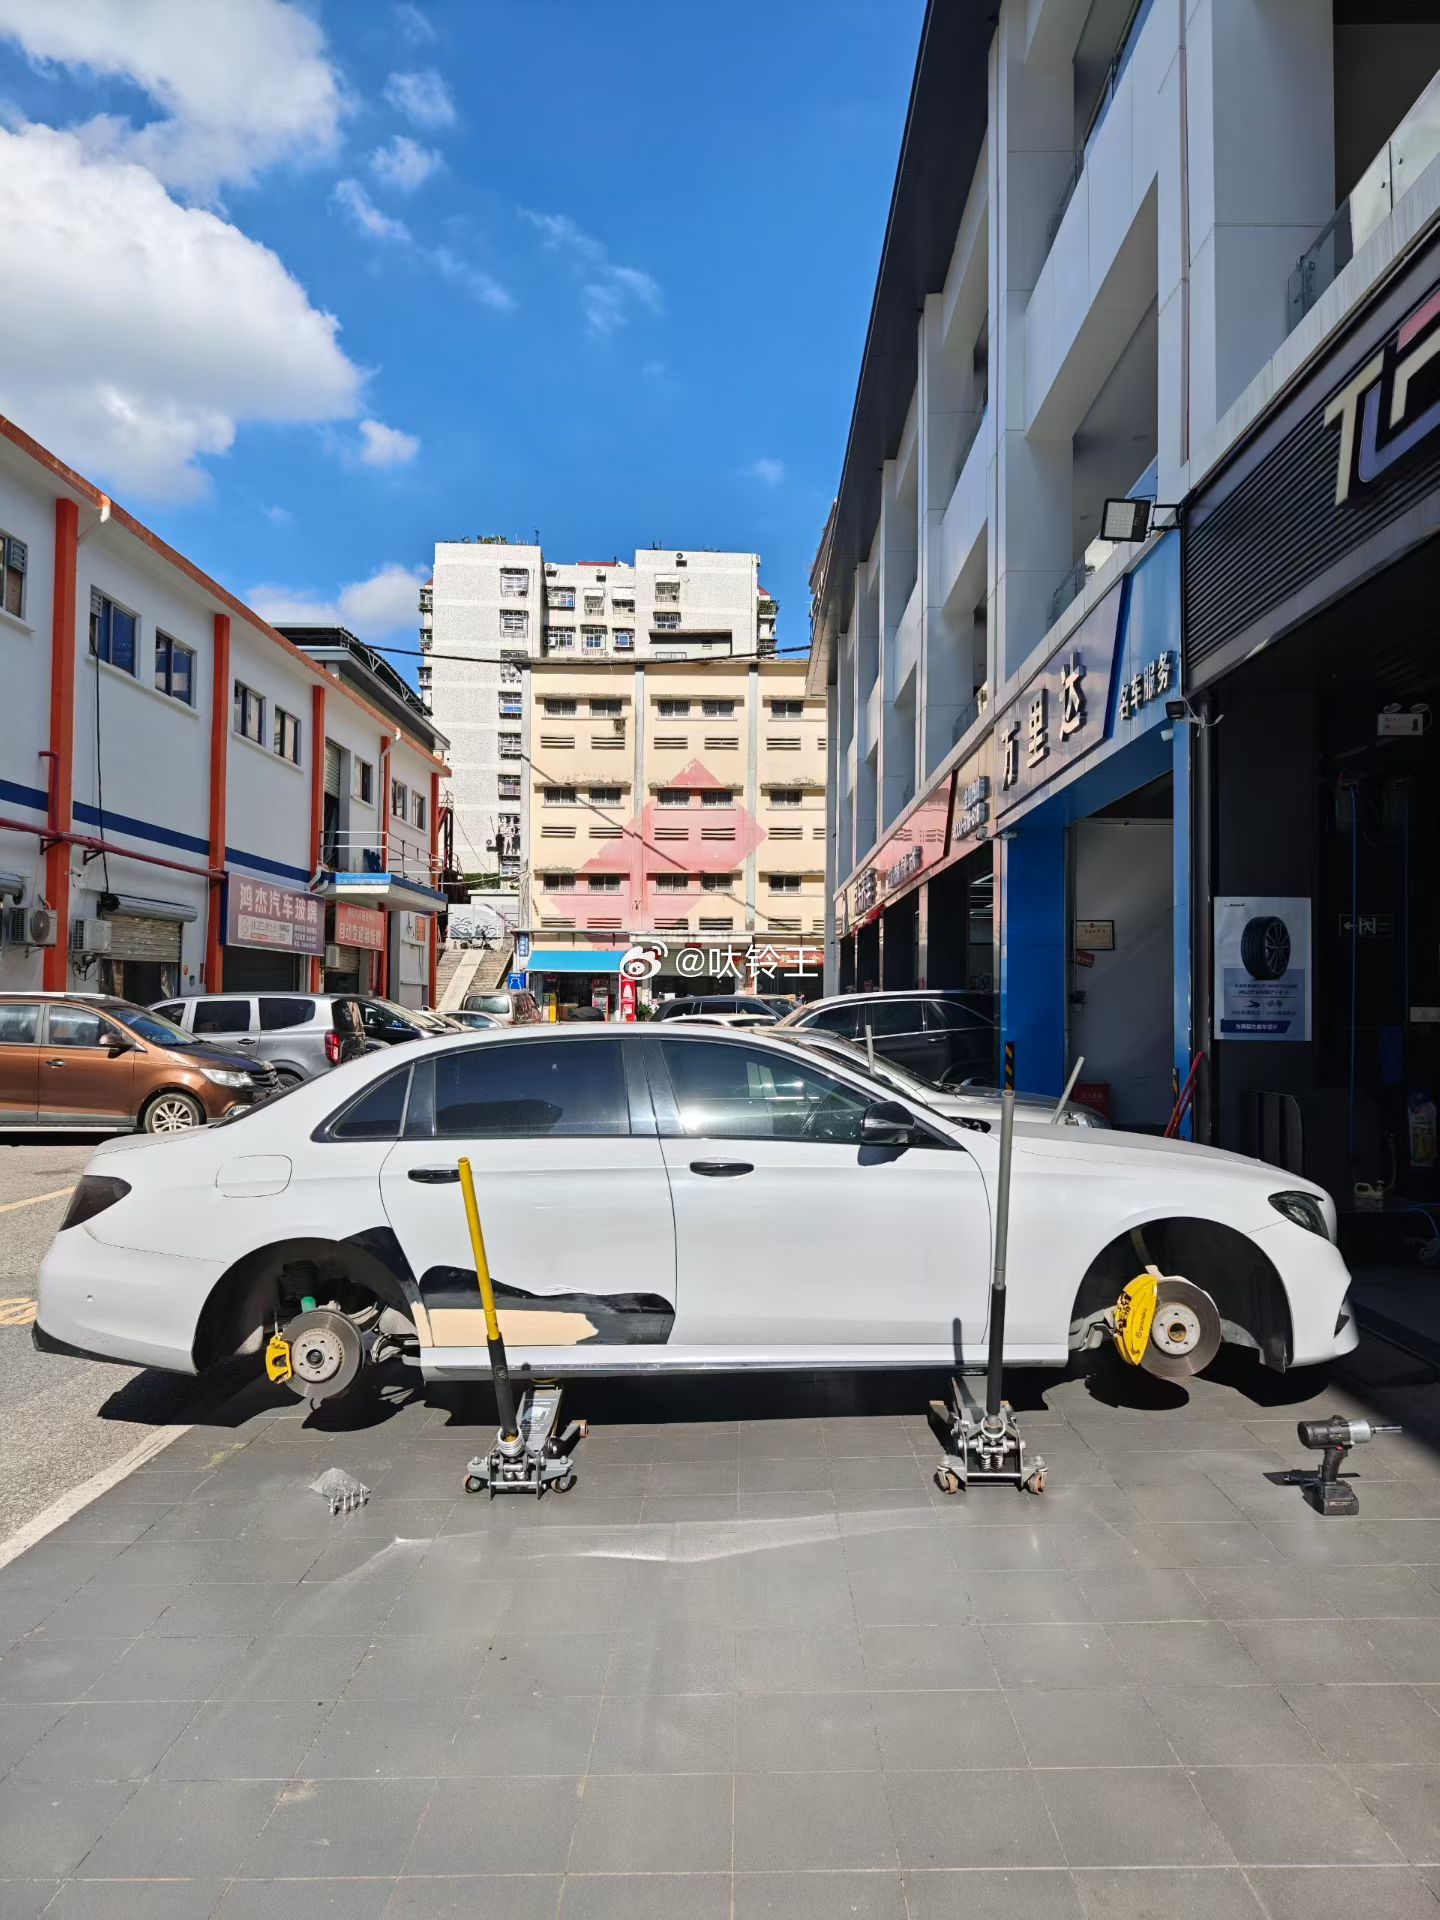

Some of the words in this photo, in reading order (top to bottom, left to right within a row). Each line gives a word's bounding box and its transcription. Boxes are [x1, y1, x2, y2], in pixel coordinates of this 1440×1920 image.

[1119, 650, 1175, 720] 名车服务
[1001, 652, 1087, 791] 万里达
[240, 883, 318, 923] 鸿杰汽车玻璃
